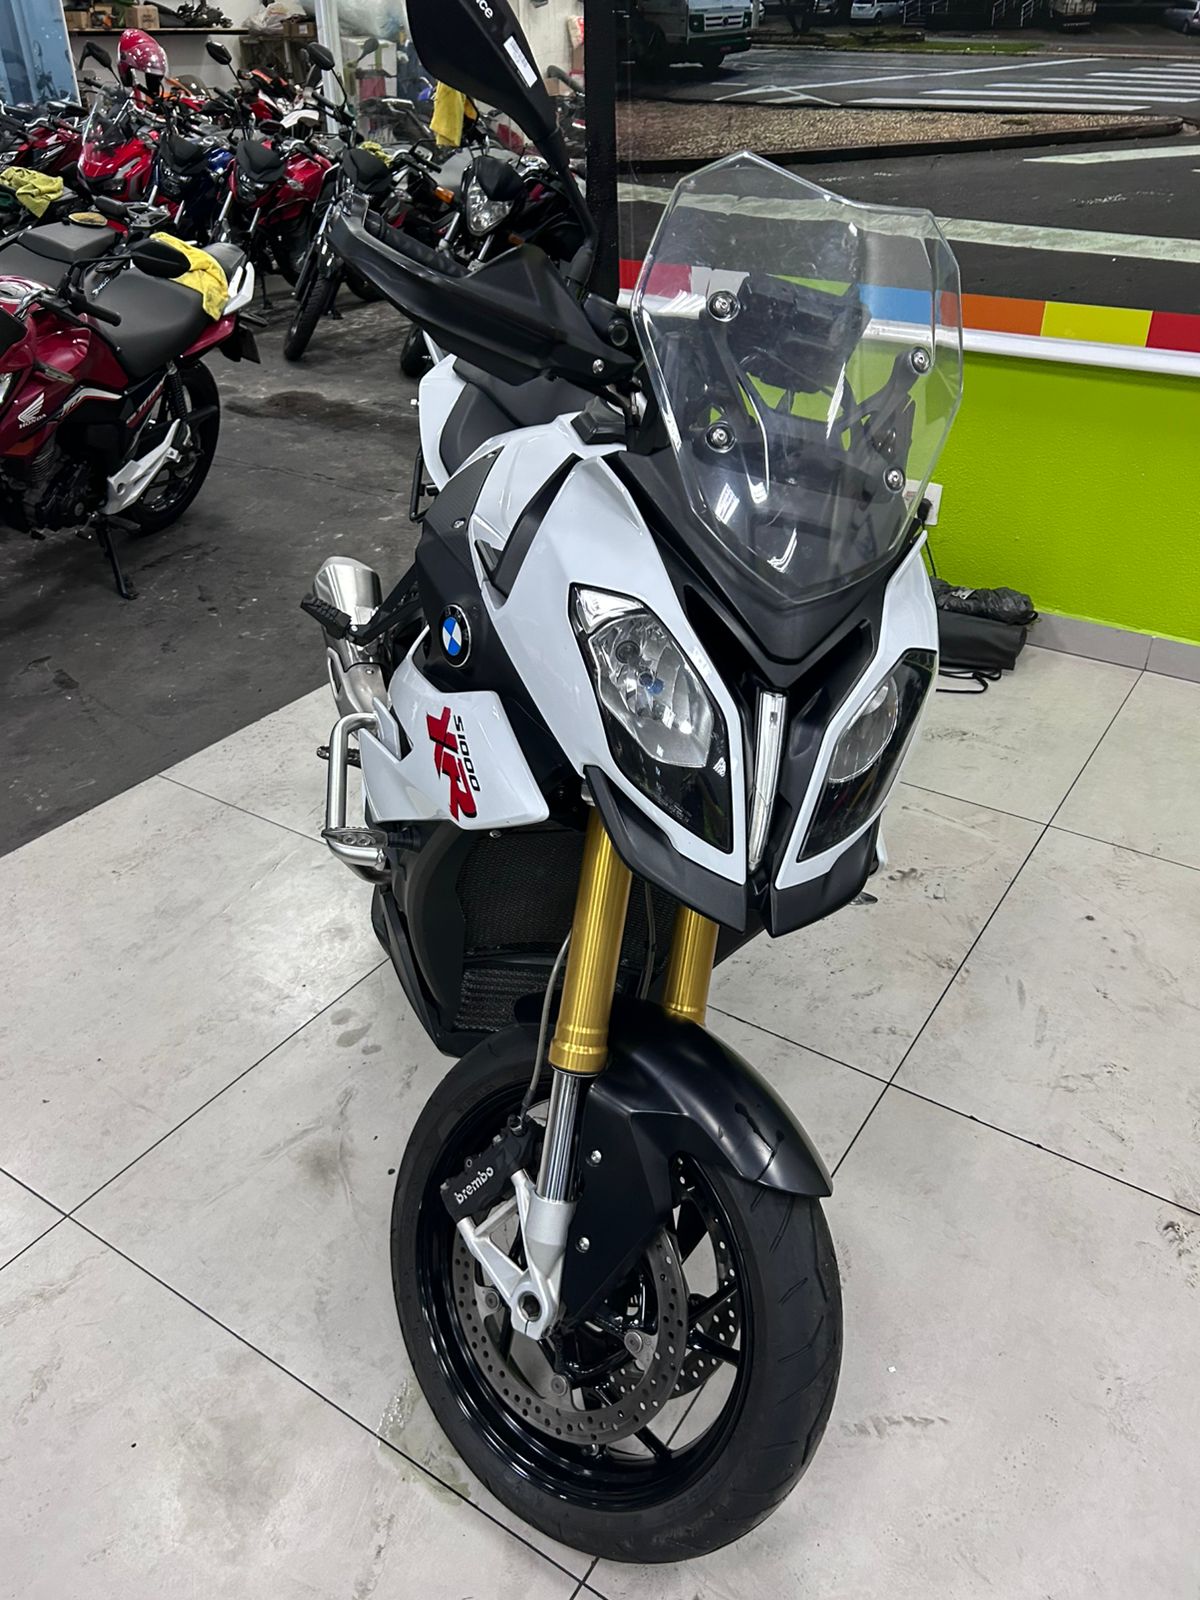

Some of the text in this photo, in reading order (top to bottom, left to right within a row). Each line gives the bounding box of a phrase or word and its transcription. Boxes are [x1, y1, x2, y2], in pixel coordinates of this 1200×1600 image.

[425, 706, 478, 822] XR
[454, 714, 481, 792] S1000
[454, 1166, 494, 1205] brembo
